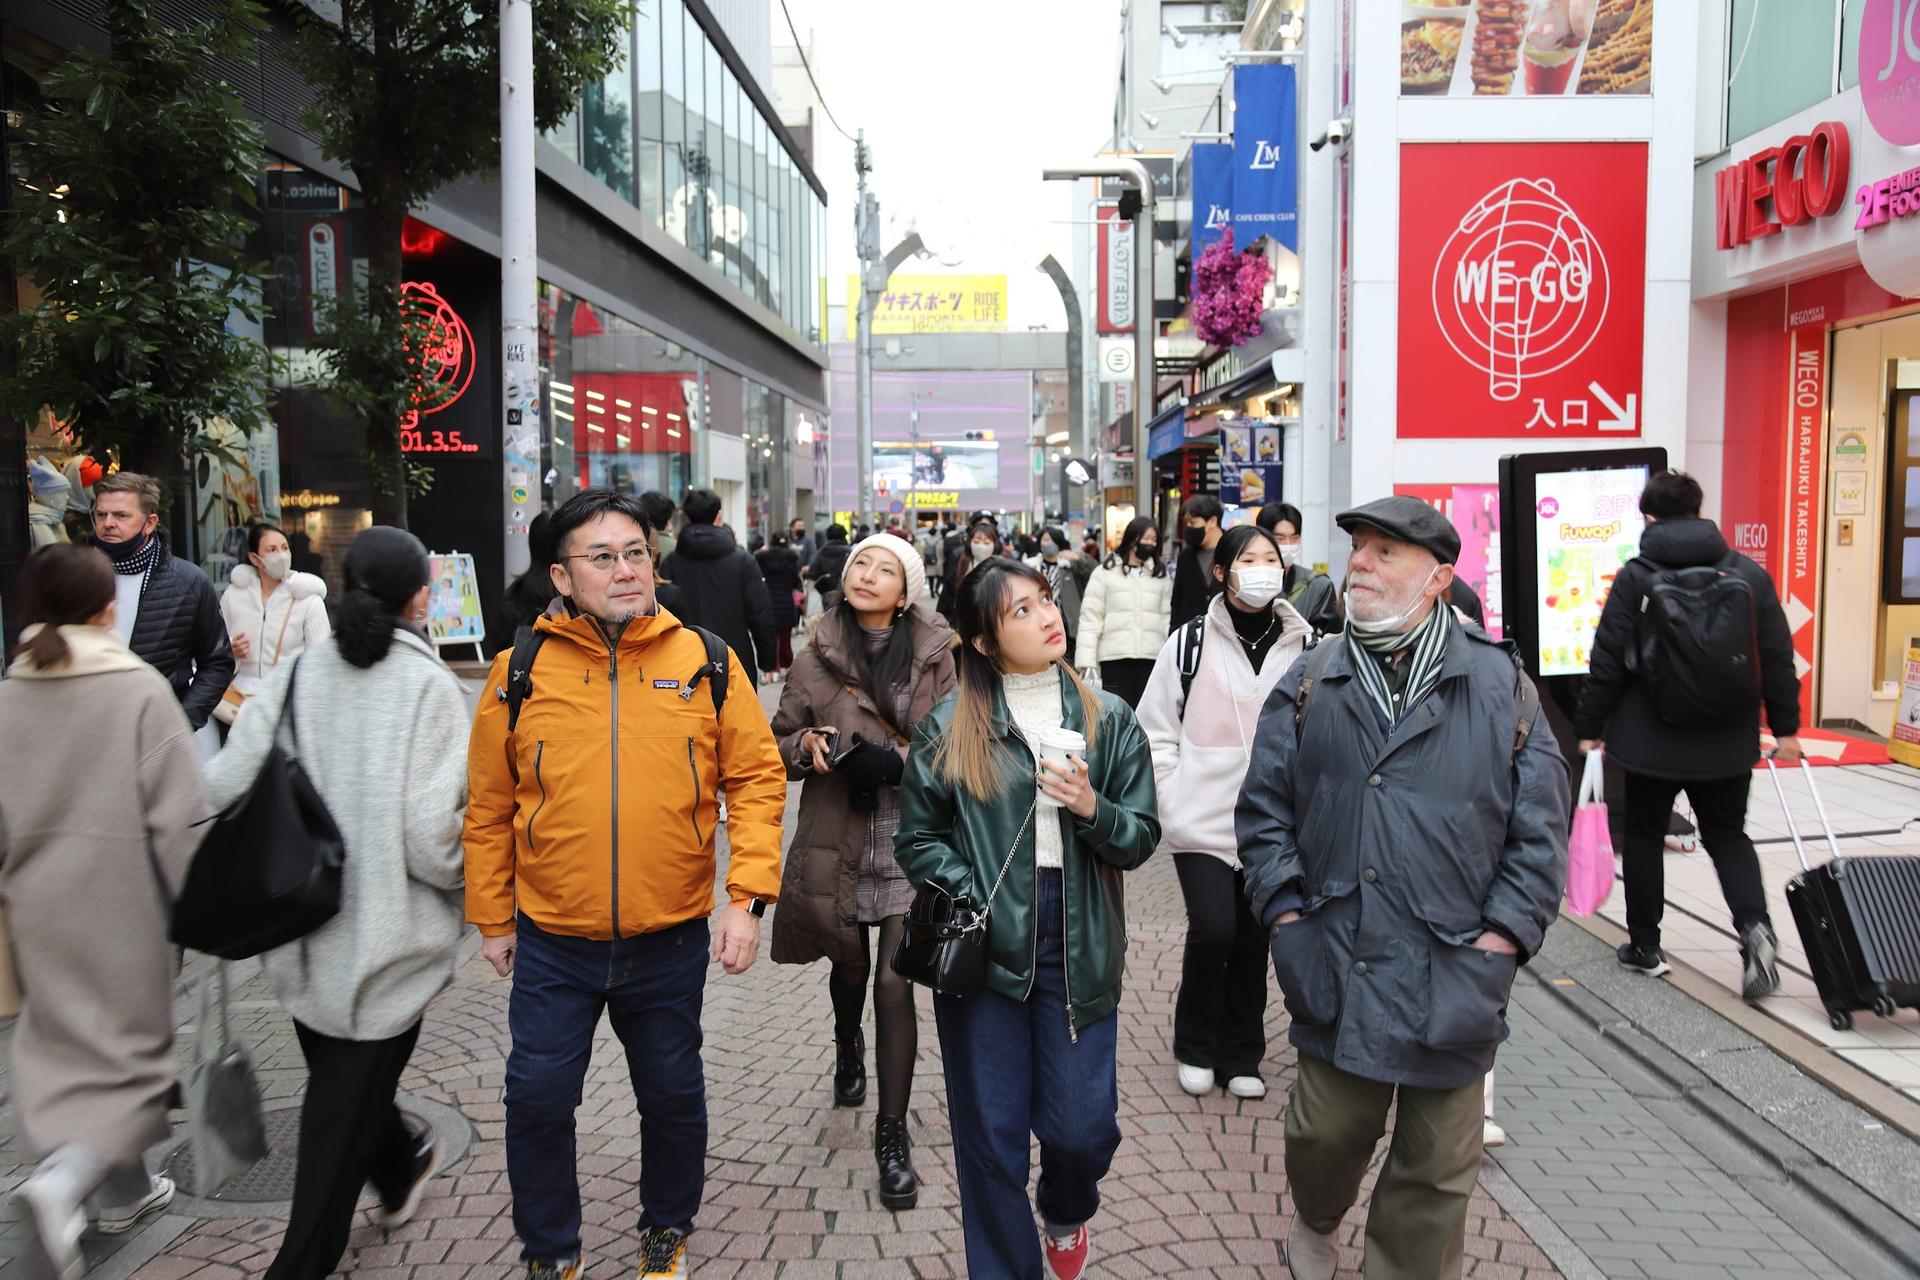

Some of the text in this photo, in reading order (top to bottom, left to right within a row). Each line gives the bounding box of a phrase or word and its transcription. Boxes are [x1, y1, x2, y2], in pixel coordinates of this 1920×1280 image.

[1716, 121, 1850, 250] WEGO
[1855, 179, 1890, 230] 2F
[1114, 236, 1129, 326] LOTTERIA
[974, 307, 1000, 321] LIFE
[1525, 398, 1588, 429] 入口
[1795, 350, 1819, 579] WEGO HARAJUKU TAKESHITA
[1734, 523, 1768, 548] WEGO
